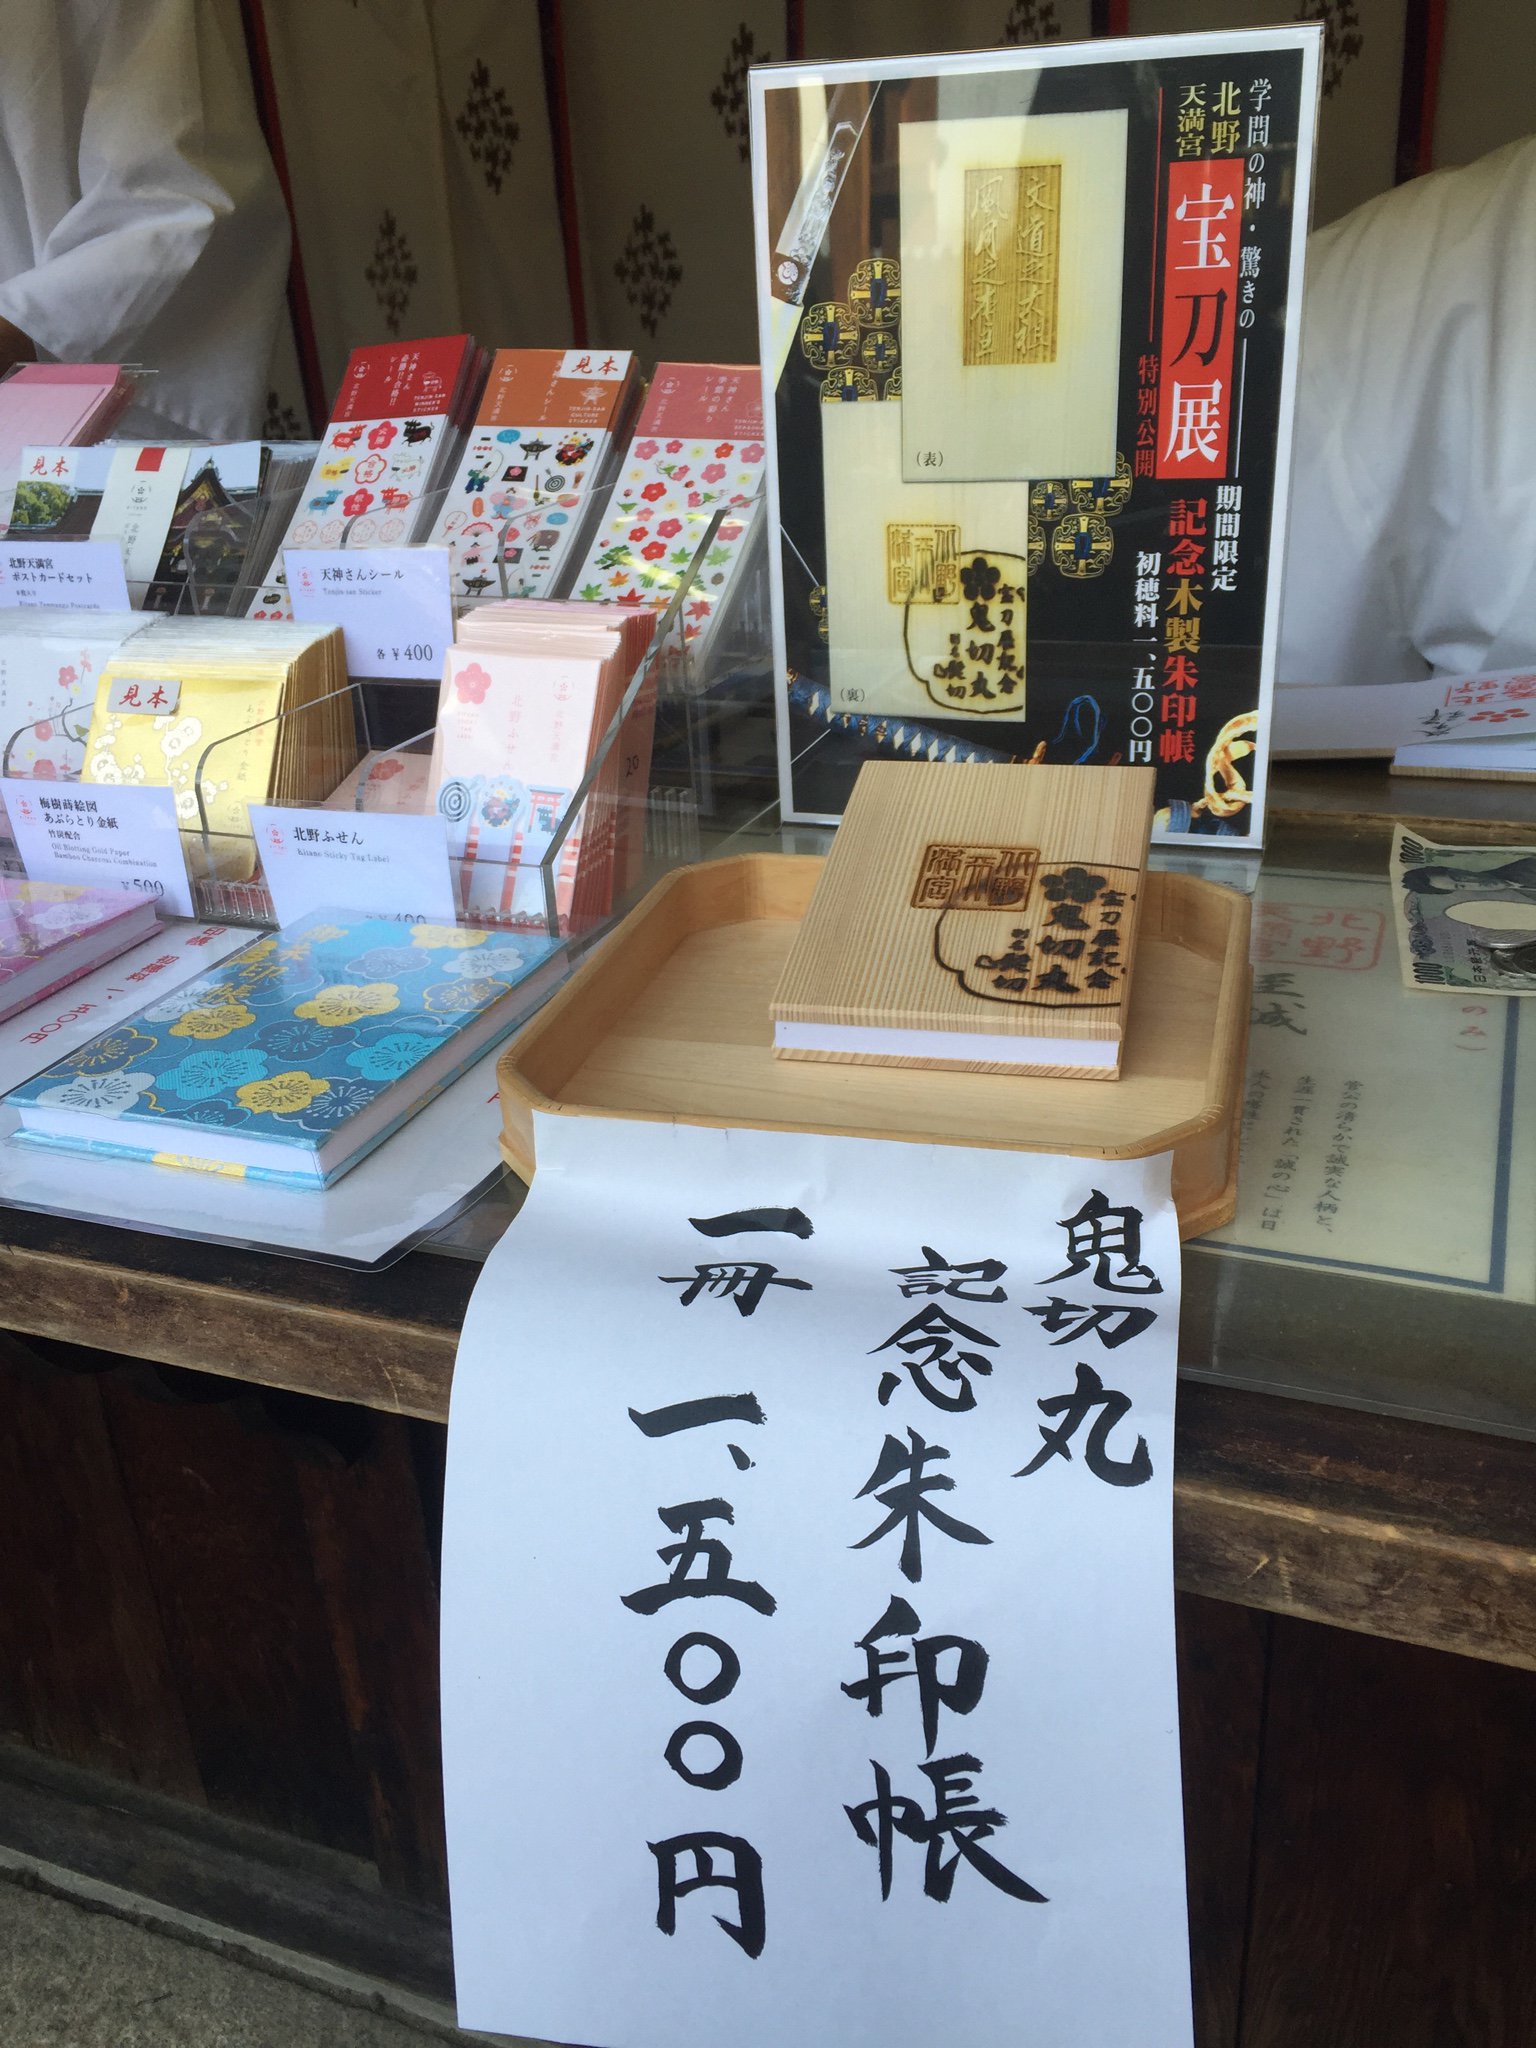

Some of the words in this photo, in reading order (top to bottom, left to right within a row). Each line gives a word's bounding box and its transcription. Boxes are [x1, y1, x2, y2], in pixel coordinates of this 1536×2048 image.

[1176, 83, 1208, 157] 天満宮
[1210, 81, 1242, 154] 北野
[1239, 77, 1273, 330] 学問の神・驚きの
[1163, 183, 1235, 464] 宝刀展
[571, 355, 618, 375] 見本
[1134, 354, 1159, 479] 特別公開
[29, 456, 70, 477] 見本
[320, 567, 404, 582] 天神さんシール
[1211, 484, 1243, 592] 期間限定
[12, 572, 93, 584] ポストカードセット
[1129, 551, 1162, 764] 初穂料一、五〇〇円
[1159, 497, 1208, 764] 記念木製朱印帳
[119, 683, 169, 708] 見本
[44, 812, 119, 830] あぶらとり金紙
[294, 827, 364, 846] 北野ふせん
[1412, 961, 1445, 986] 1000
[657, 1205, 815, 1317] 一冊
[1013, 1189, 1163, 1488] 鬼切丸
[840, 1245, 1051, 1905] 記念朱印帳
